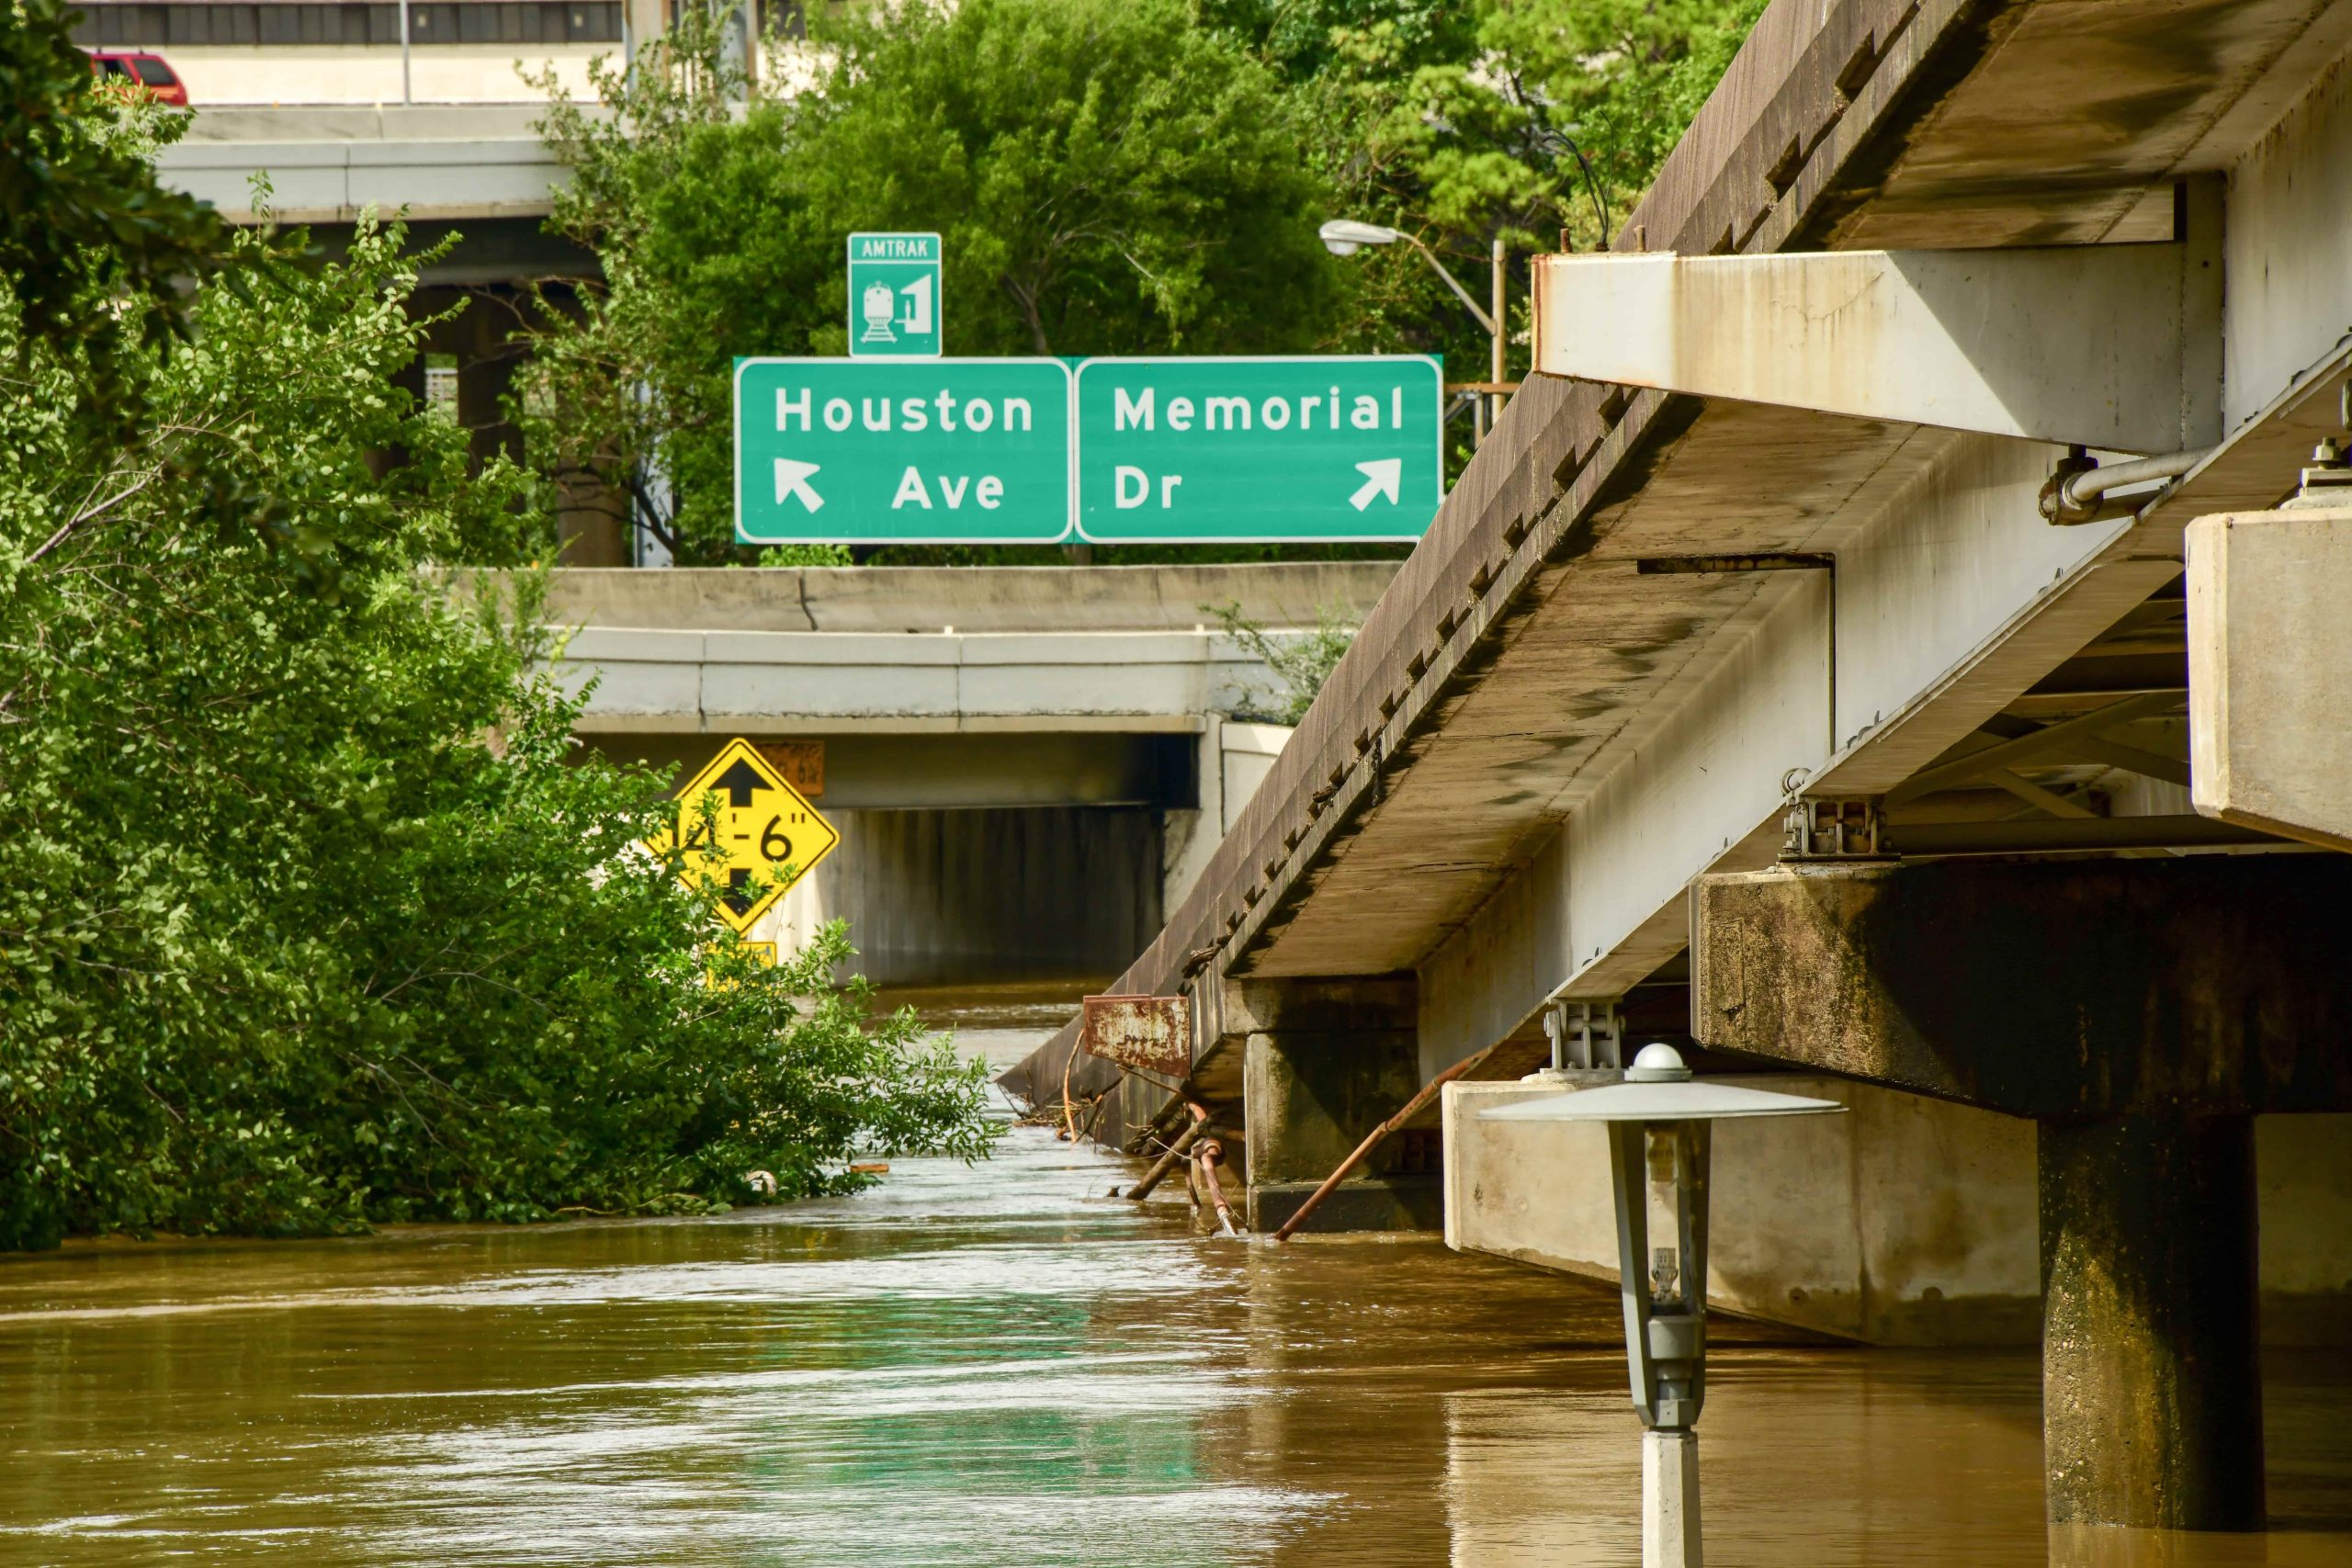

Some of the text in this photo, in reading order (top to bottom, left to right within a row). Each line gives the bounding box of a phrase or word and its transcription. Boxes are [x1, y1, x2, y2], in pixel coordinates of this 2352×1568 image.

[862, 239, 928, 257] AMTRAK
[775, 388, 1032, 432] Houston
[1114, 386, 1402, 431] Memorial
[891, 466, 1004, 510] Ave
[1115, 466, 1182, 509] Dr
